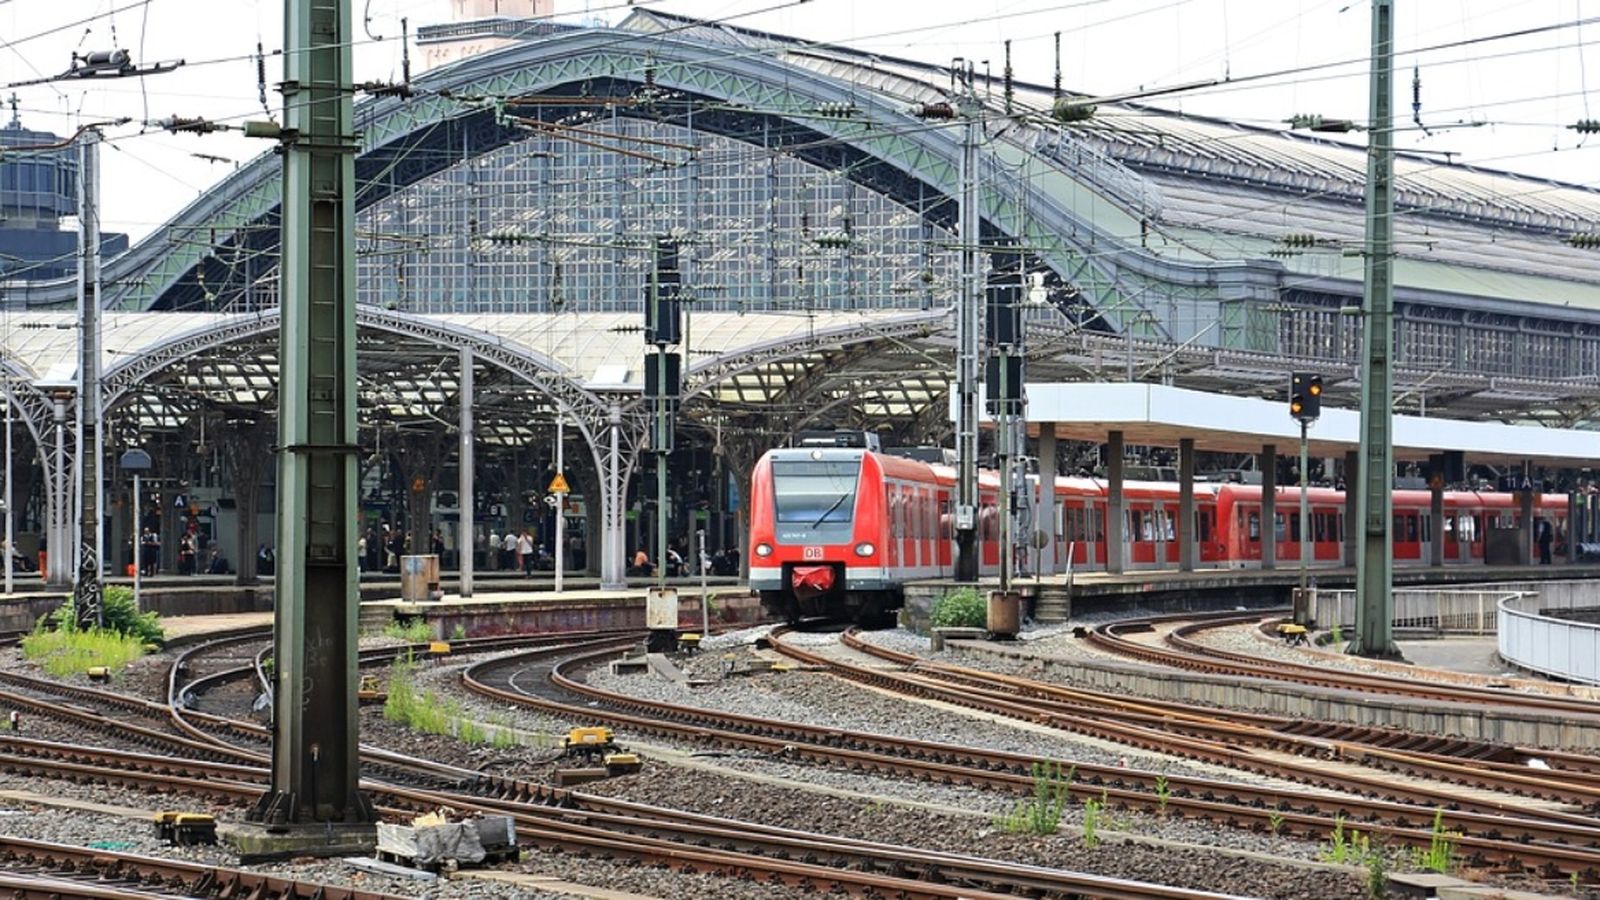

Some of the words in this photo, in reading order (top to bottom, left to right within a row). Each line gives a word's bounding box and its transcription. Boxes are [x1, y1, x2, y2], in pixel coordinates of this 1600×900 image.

[1506, 477, 1515, 488] 11
[1522, 476, 1531, 488] A
[174, 496, 184, 506] A
[805, 548, 822, 558] DB
